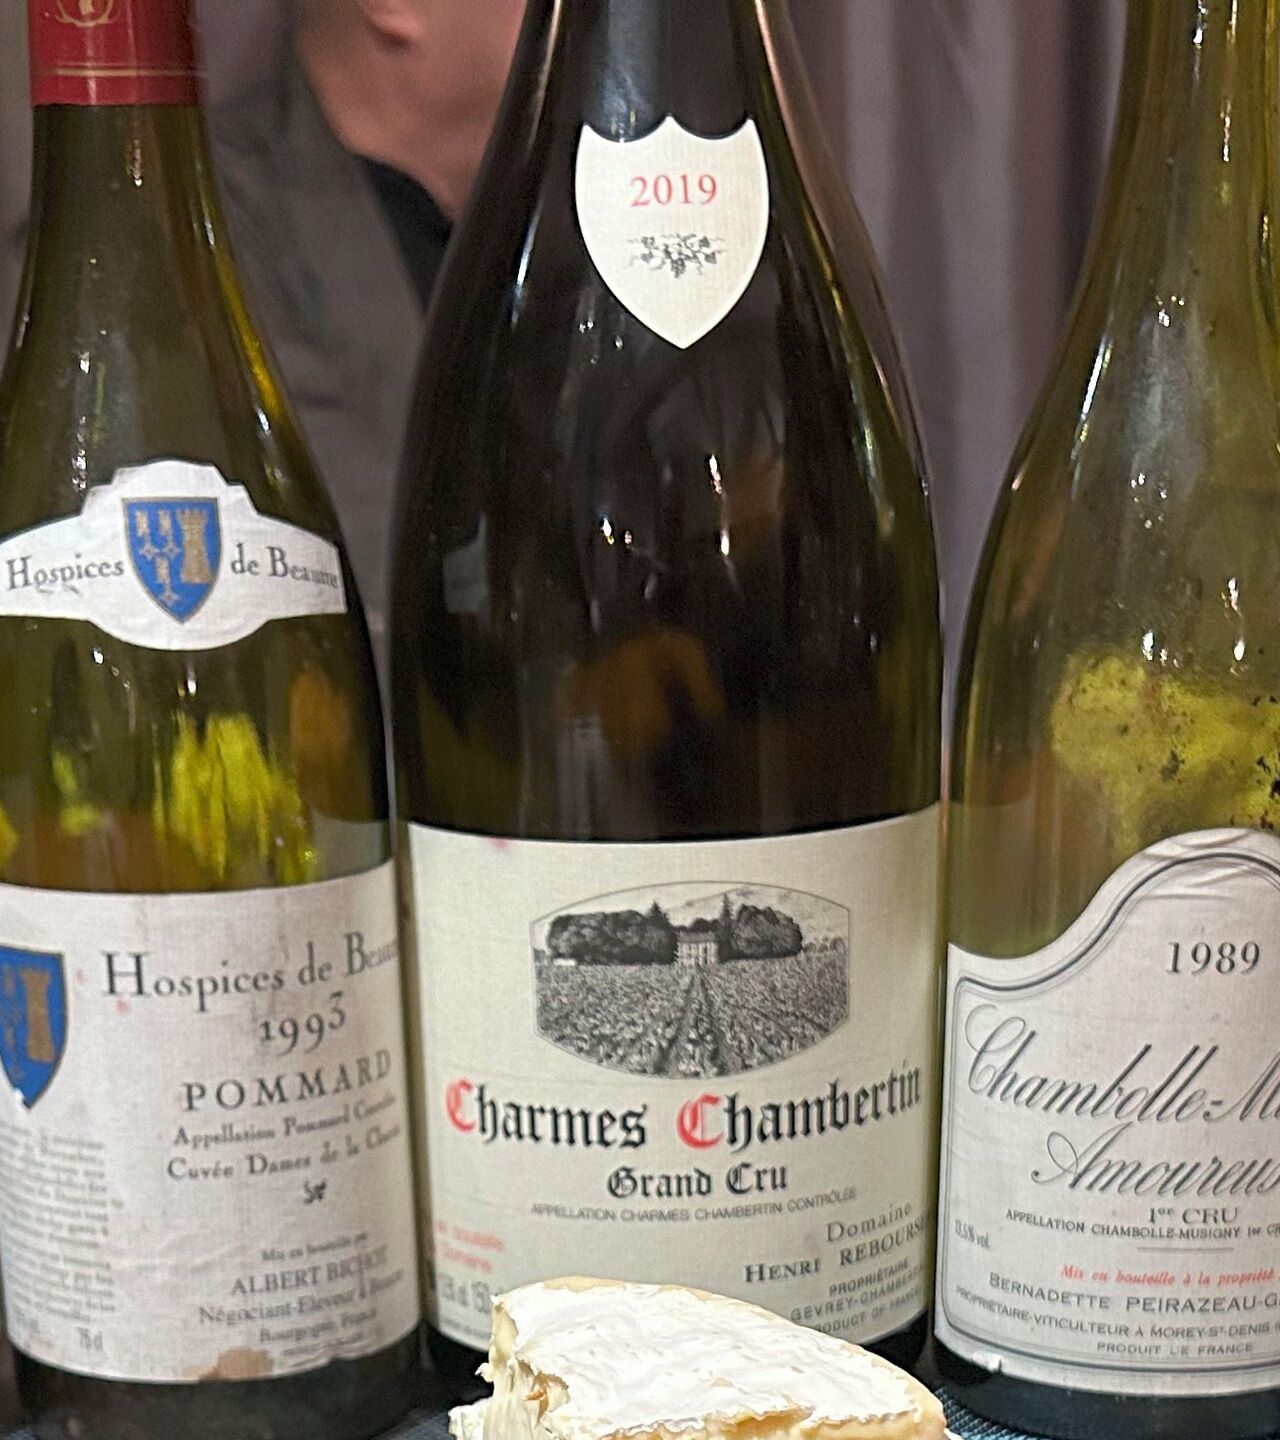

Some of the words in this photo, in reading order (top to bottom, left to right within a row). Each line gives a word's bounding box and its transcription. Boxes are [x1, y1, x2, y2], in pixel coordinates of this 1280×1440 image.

[629, 173, 718, 207] 2019
[6, 552, 125, 596] Hospices
[231, 543, 260, 576] de
[1166, 941, 1261, 976] 1989
[104, 949, 285, 1013] Hospices
[298, 941, 332, 985] de
[259, 990, 347, 1057] 1993
[181, 1047, 392, 1113] POMMARD
[444, 1078, 650, 1152] Charmes
[675, 1060, 921, 1156] Chambertin
[607, 1165, 712, 1200] Grand
[725, 1161, 789, 1196] Cru
[530, 1202, 618, 1222] APPELLATION
[620, 1207, 690, 1224] CHARMES
[694, 1200, 784, 1222] CHAMBERTIN
[826, 1201, 913, 1244] Domaine
[1006, 1208, 1086, 1234] APPELLATION
[1090, 1221, 1241, 1240] CHAMBOLLE-MUSIGNY
[1181, 1206, 1239, 1226] CRU
[230, 1264, 322, 1297] ALBERT
[744, 1257, 823, 1284] HENRI
[1060, 1263, 1084, 1281] Mis
[1091, 1269, 1109, 1281] en
[1115, 1269, 1175, 1287] bouteille
[1197, 1270, 1211, 1285] la
[988, 1271, 1112, 1310] BERNADETTE
[1096, 1340, 1162, 1356] PRODUIT
[1197, 1342, 1254, 1357] FRANCE
